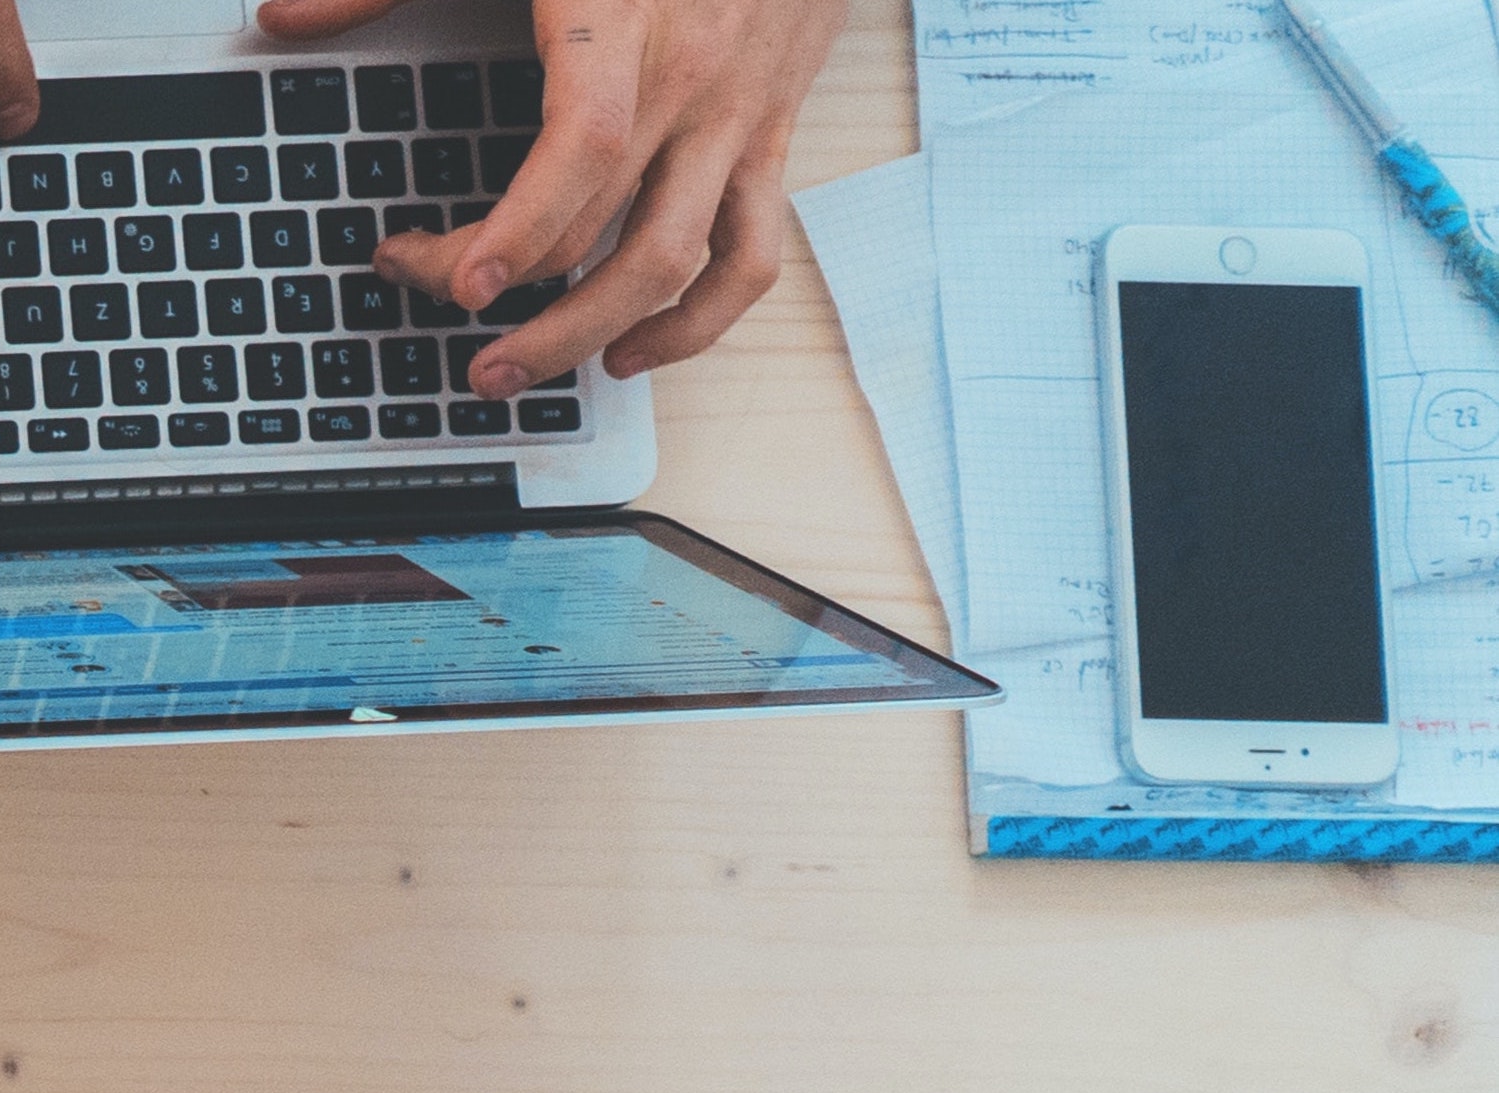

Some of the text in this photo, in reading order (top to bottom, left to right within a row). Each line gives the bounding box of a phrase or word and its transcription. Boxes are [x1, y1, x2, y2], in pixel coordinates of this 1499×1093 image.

[31, 161, 383, 190] Y X C V B N
[138, 233, 156, 253] G
[209, 232, 221, 251] F
[273, 228, 290, 248] D
[342, 226, 356, 244] S
[6, 239, 16, 257] J
[71, 237, 88, 255] H
[164, 300, 176, 318] T
[230, 297, 244, 315] R
[300, 293, 312, 313] E
[364, 292, 382, 308] W
[26, 304, 43, 323] U
[95, 301, 109, 321] Z
[202, 353, 214, 372] 5
[270, 352, 283, 369] 4
[338, 348, 349, 365] 3
[406, 345, 417, 362] 2
[67, 359, 79, 377] 7
[133, 356, 146, 374] 6
